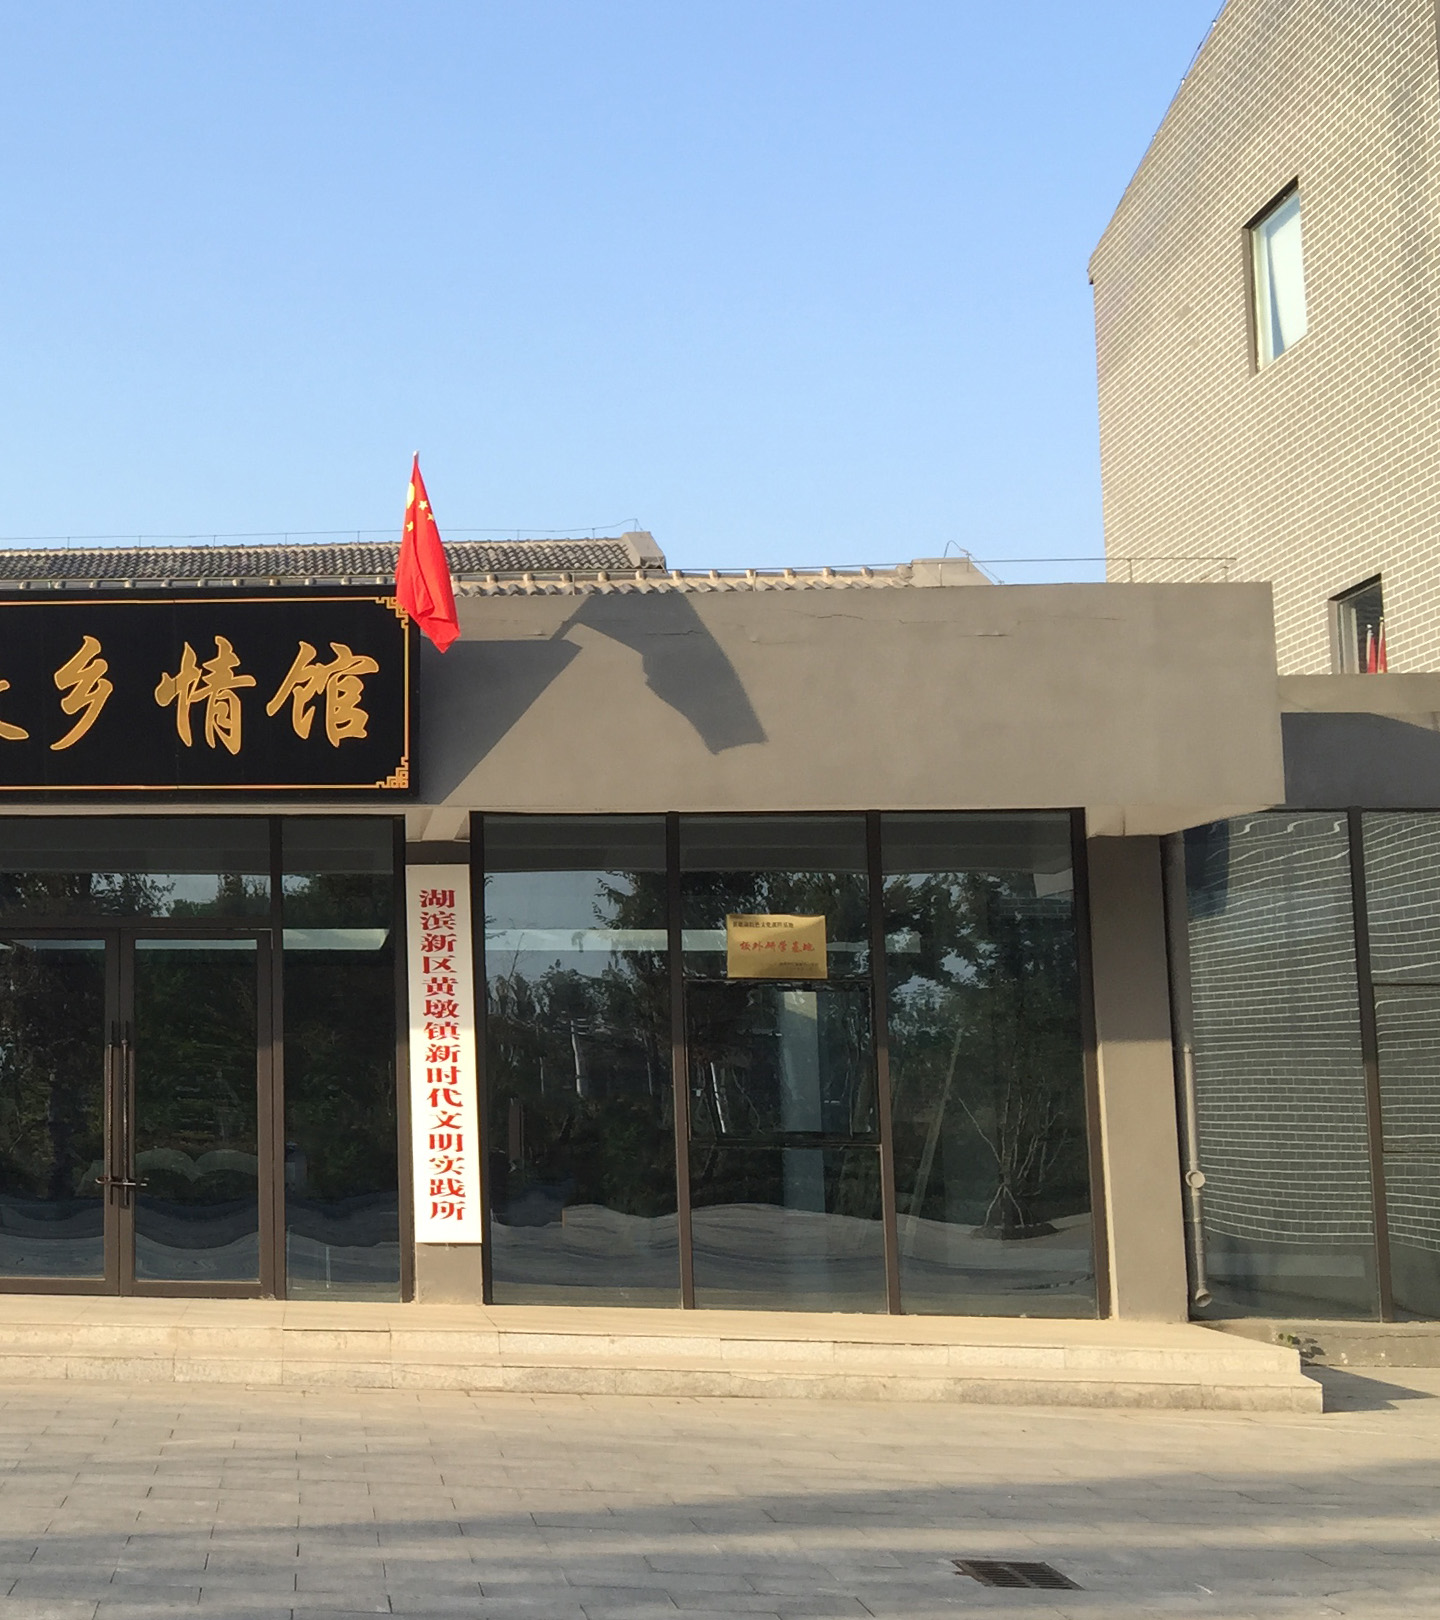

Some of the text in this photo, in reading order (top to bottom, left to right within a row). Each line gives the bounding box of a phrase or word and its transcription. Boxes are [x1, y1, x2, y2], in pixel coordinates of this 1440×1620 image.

[419, 888, 466, 1220] 湖滨新区黄墩镇新时代文明实践所
